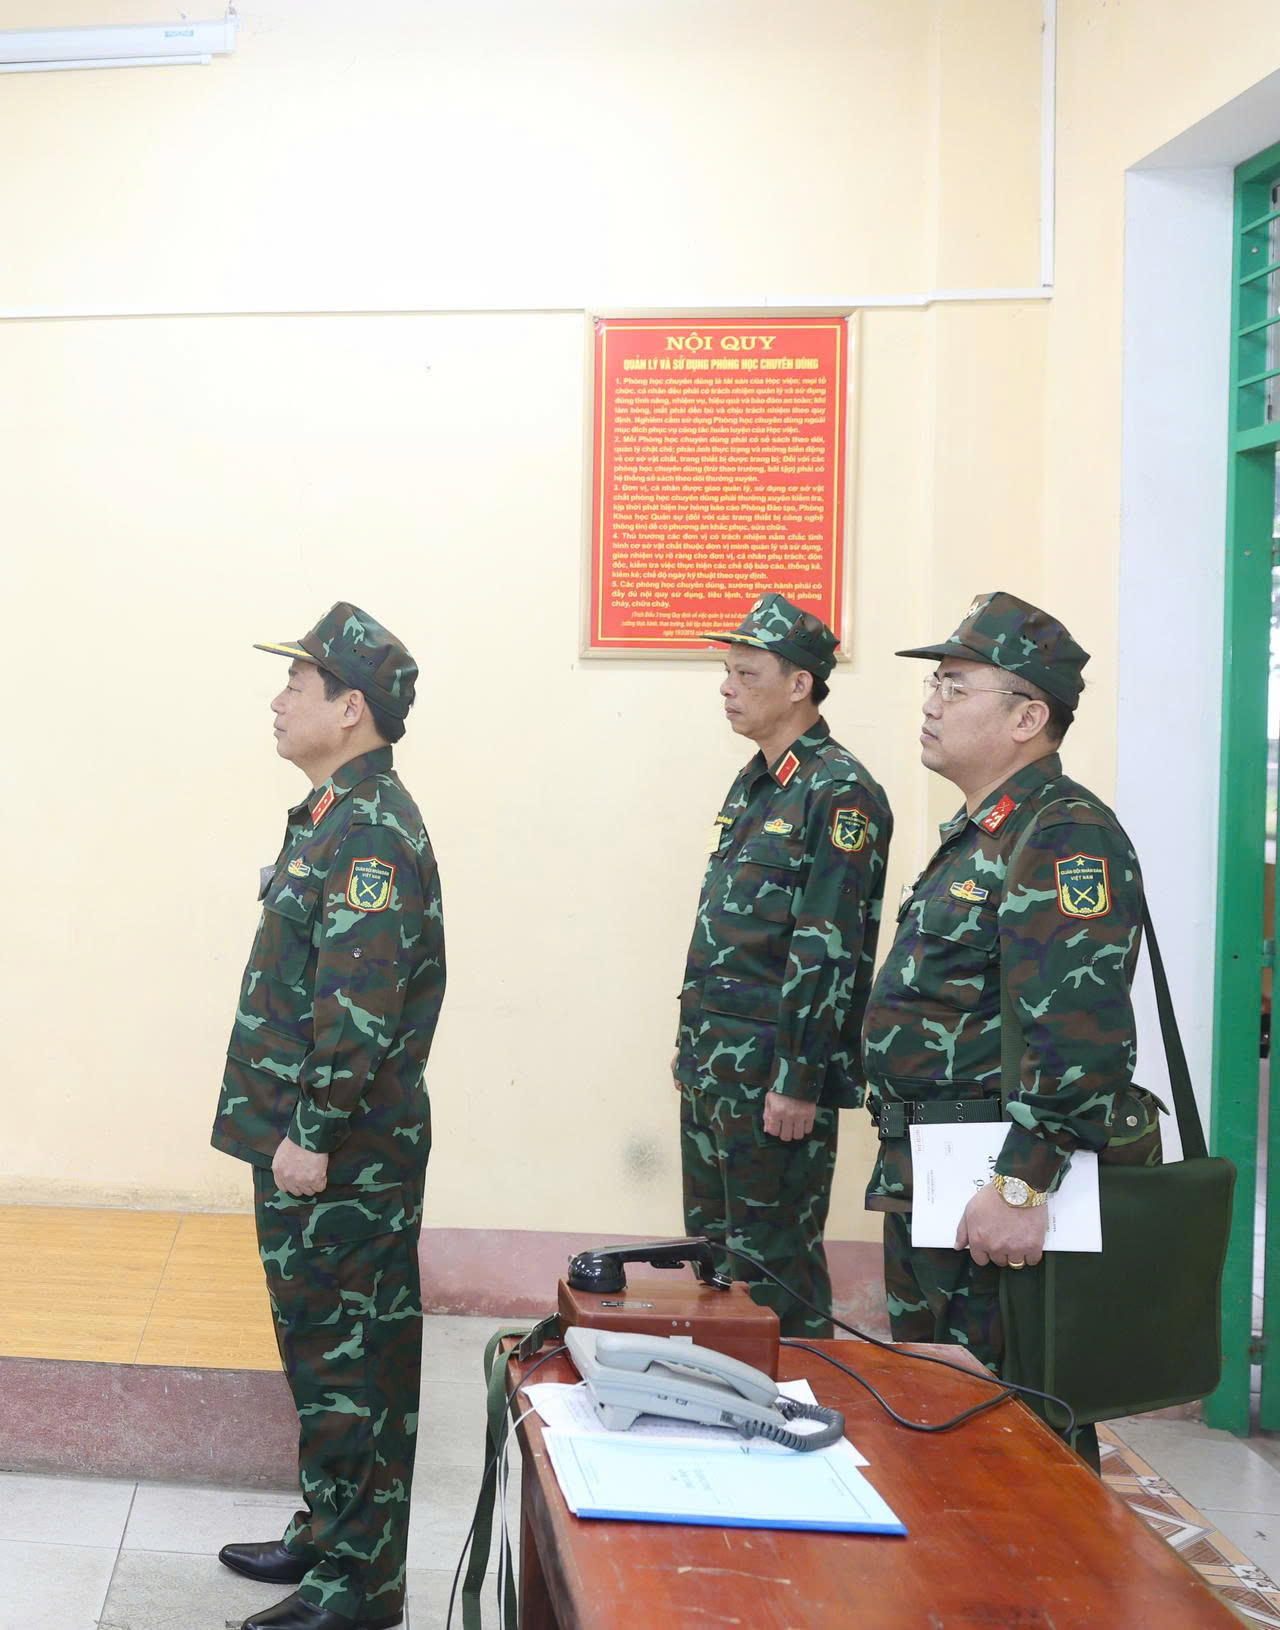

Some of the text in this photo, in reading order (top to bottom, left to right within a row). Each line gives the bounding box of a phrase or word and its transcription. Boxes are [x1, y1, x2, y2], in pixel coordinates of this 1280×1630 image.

[665, 331, 777, 354] NỘI QUY
[623, 354, 819, 372] QUẢN LÝ VÀ SỬ DỤNG PHÒNG HỌC CHUYÊN DÙNG
